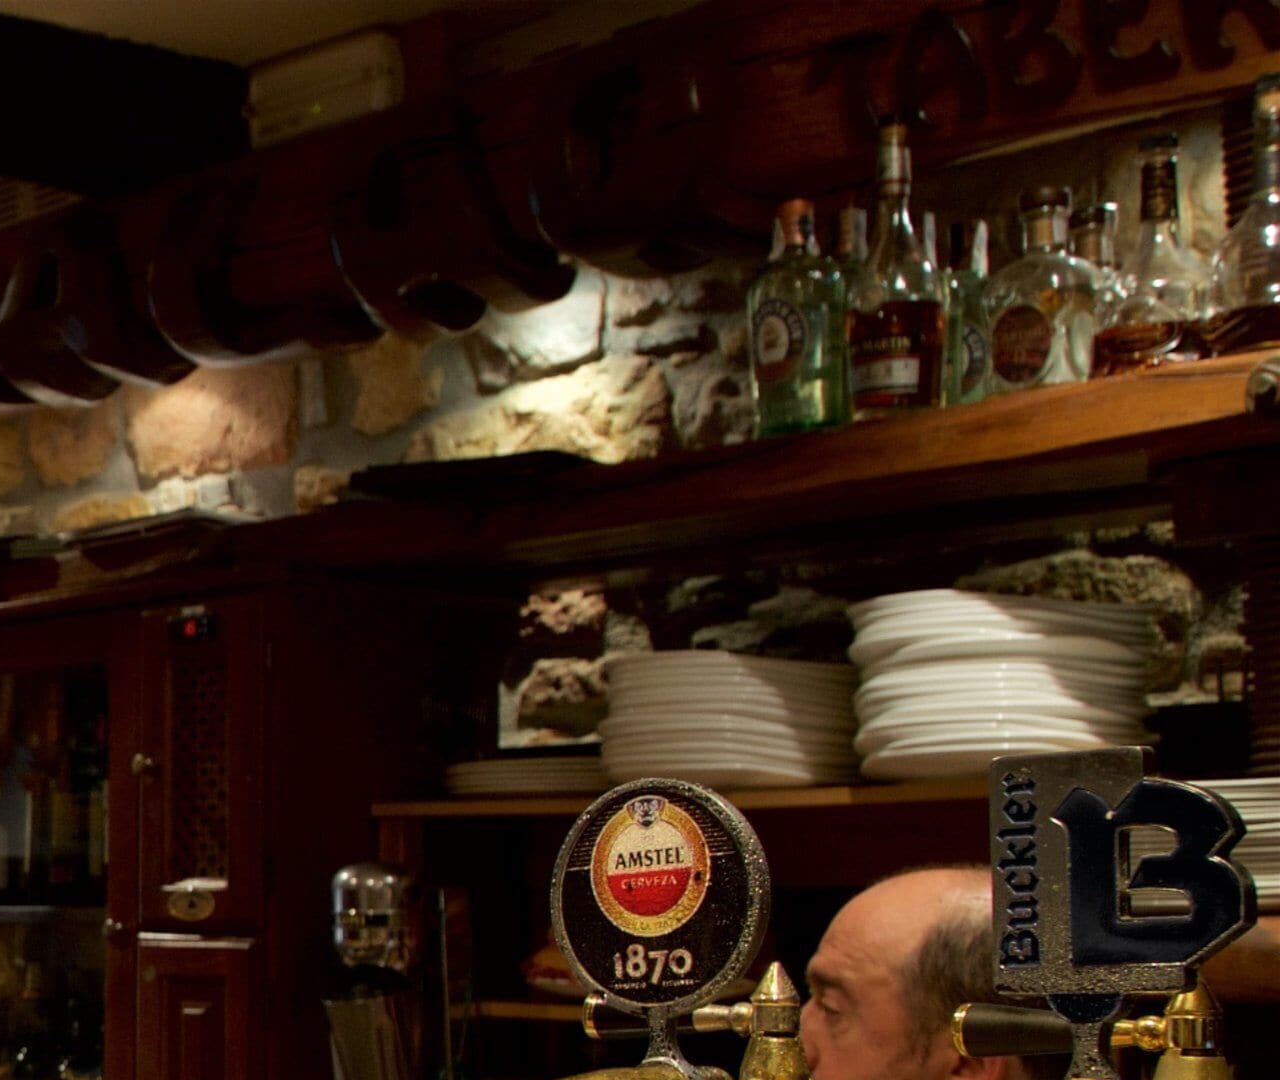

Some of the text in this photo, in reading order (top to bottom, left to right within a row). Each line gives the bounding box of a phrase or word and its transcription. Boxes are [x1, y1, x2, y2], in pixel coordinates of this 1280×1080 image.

[615, 846, 684, 870] AMSTEL
[996, 772, 1040, 968] Buckler
[1051, 776, 1257, 968] B
[621, 874, 678, 890] CERVEZA
[613, 943, 693, 985] 1870
